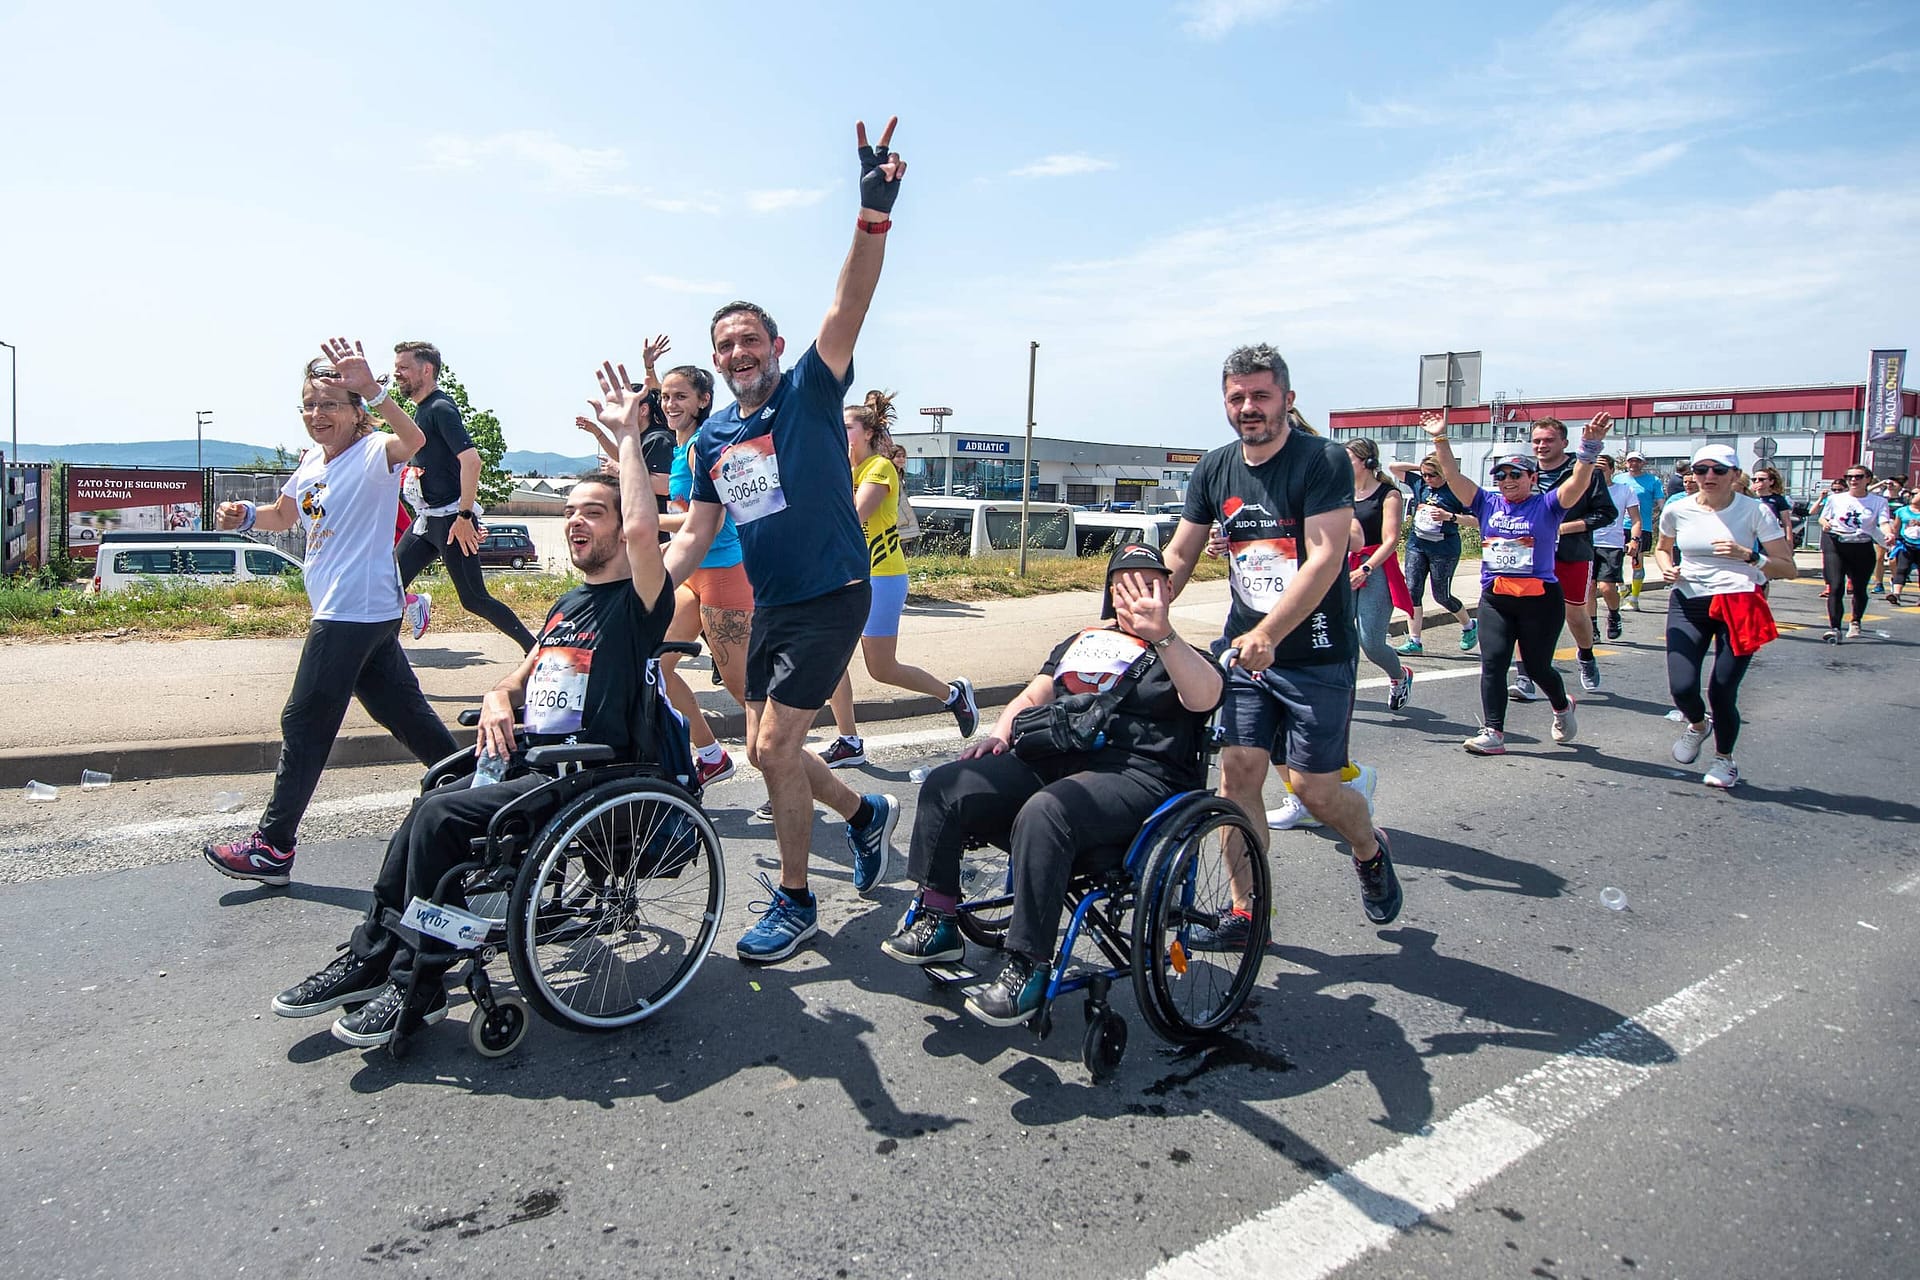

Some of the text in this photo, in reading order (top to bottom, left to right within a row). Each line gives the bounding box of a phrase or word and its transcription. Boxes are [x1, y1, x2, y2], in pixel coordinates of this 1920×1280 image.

[964, 441, 1005, 452] ADRIATIC
[77, 478, 188, 490] ZATO ŠTO JE SIGURNOST
[727, 475, 768, 504] 30648
[77, 489, 132, 499] NAJVAŽNIJA
[1234, 520, 1257, 529] JUDO
[1496, 555, 1517, 565] 508
[1311, 612, 1334, 649] 柔道
[416, 908, 450, 929] W107
